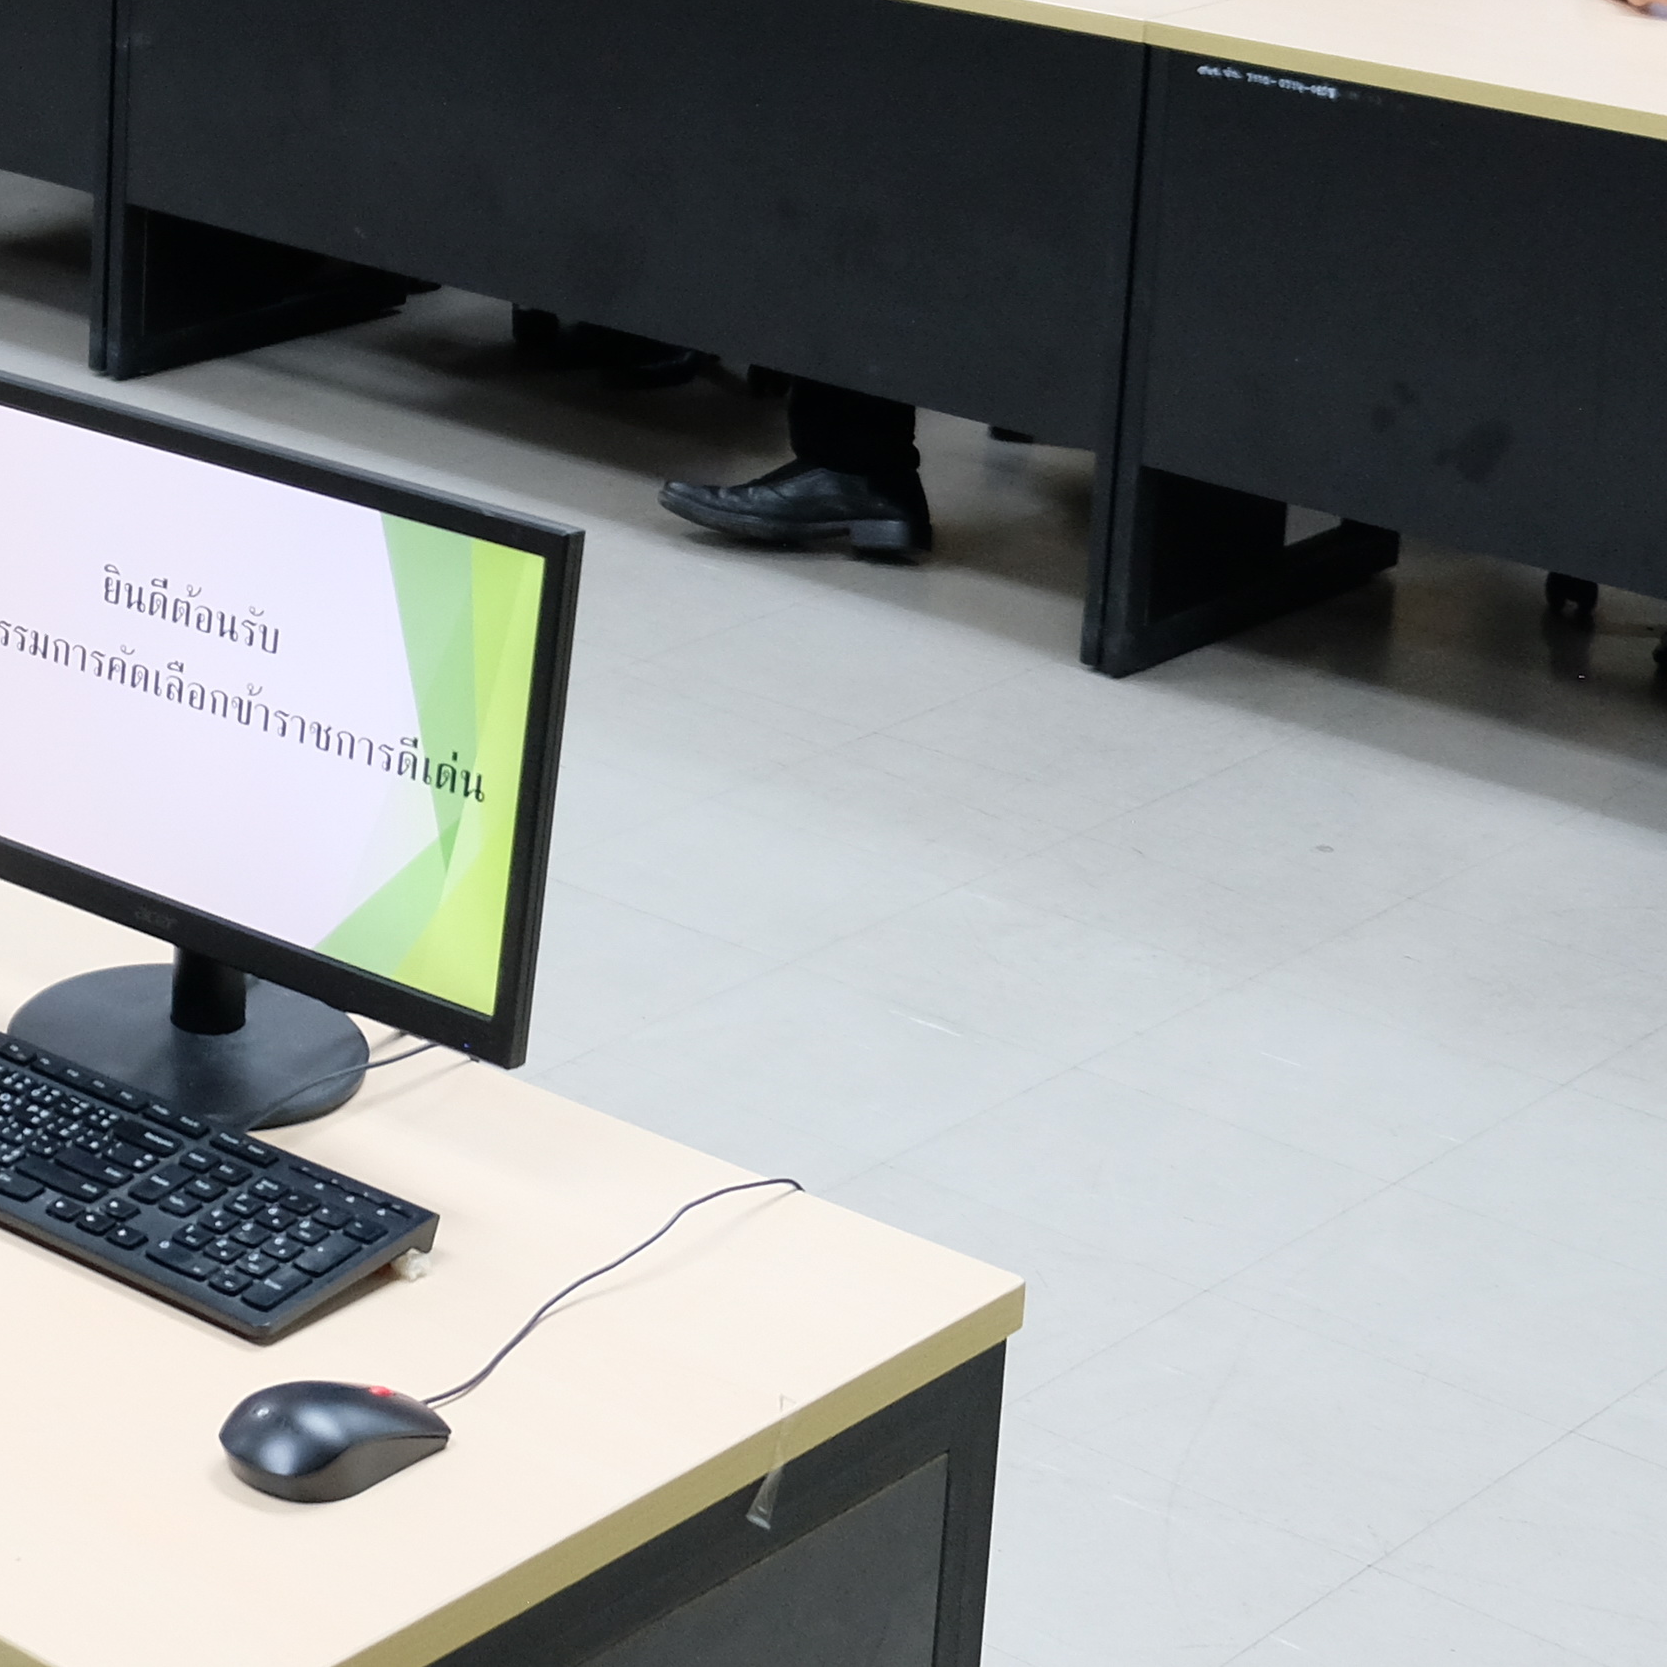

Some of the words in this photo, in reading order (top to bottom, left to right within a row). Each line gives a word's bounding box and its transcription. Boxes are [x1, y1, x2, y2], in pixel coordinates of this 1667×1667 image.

[104, 563, 280, 655] ยินดีต้อนรับ
